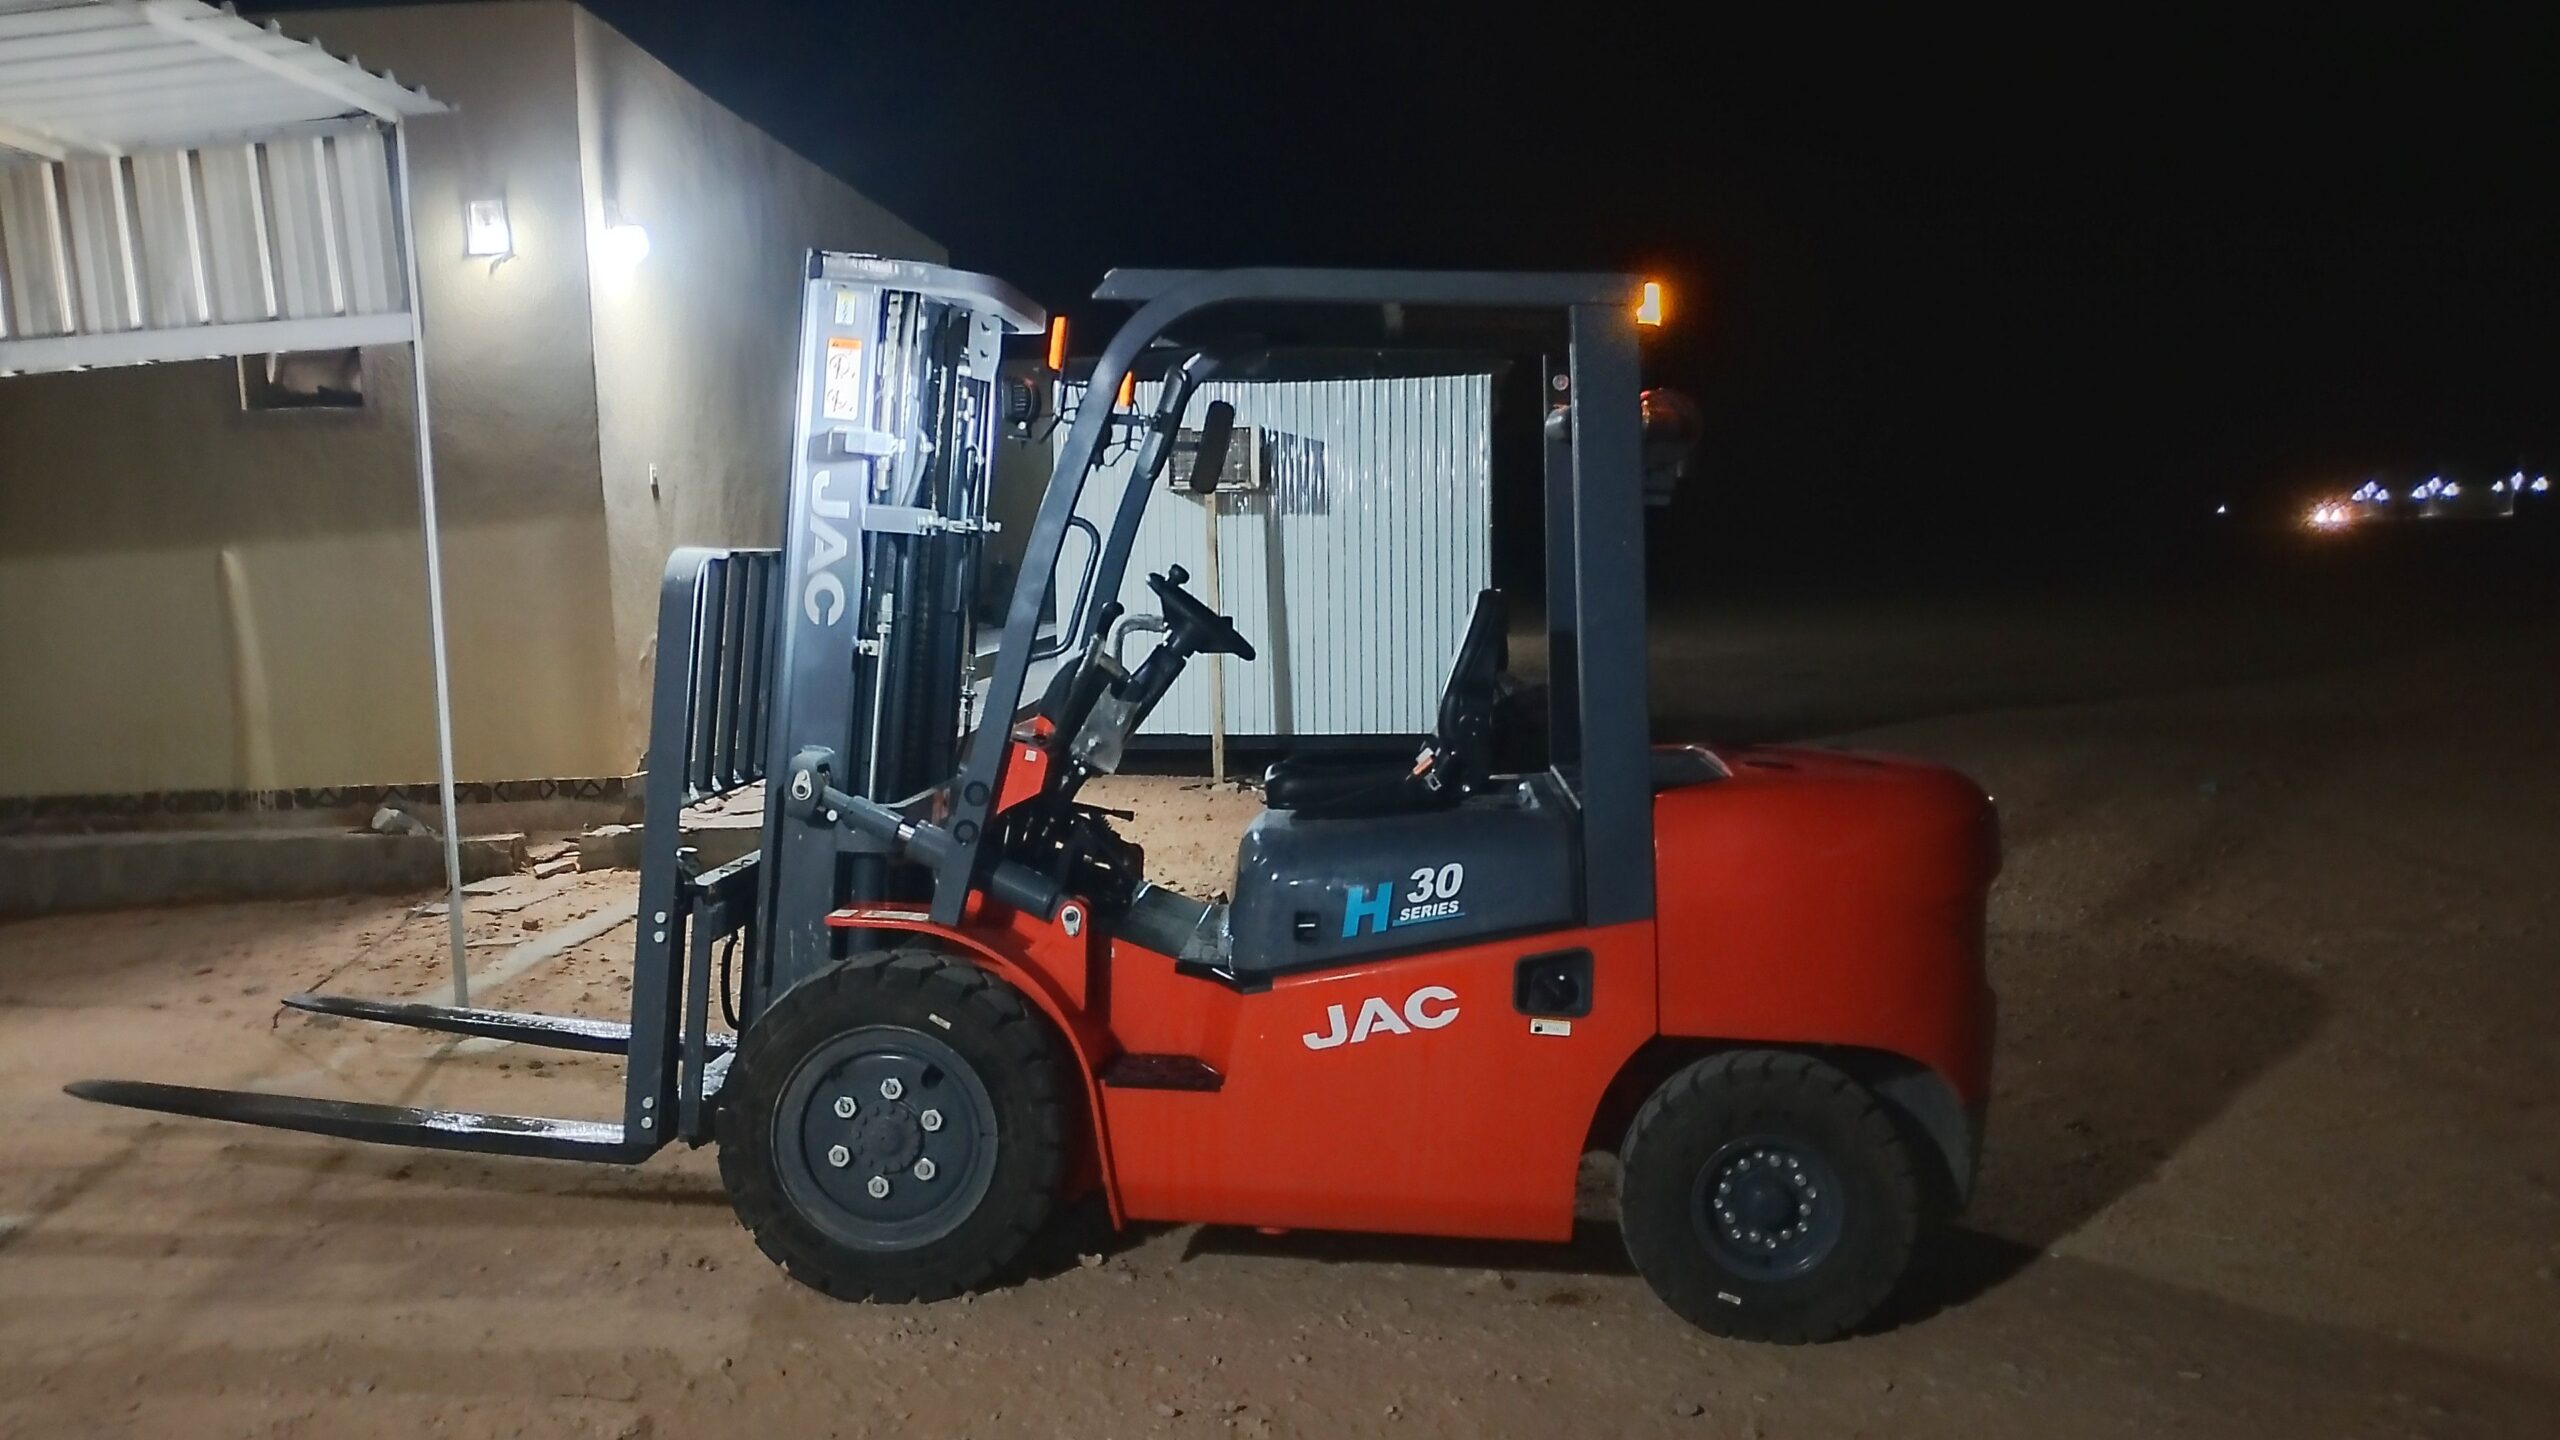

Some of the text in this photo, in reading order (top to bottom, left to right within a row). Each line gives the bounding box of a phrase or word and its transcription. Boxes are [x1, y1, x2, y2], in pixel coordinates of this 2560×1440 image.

[804, 470, 850, 626] JAC
[1343, 863, 1464, 938] H 30
[1400, 900, 1460, 921] SERIES
[1303, 986, 1460, 1050] JAC
